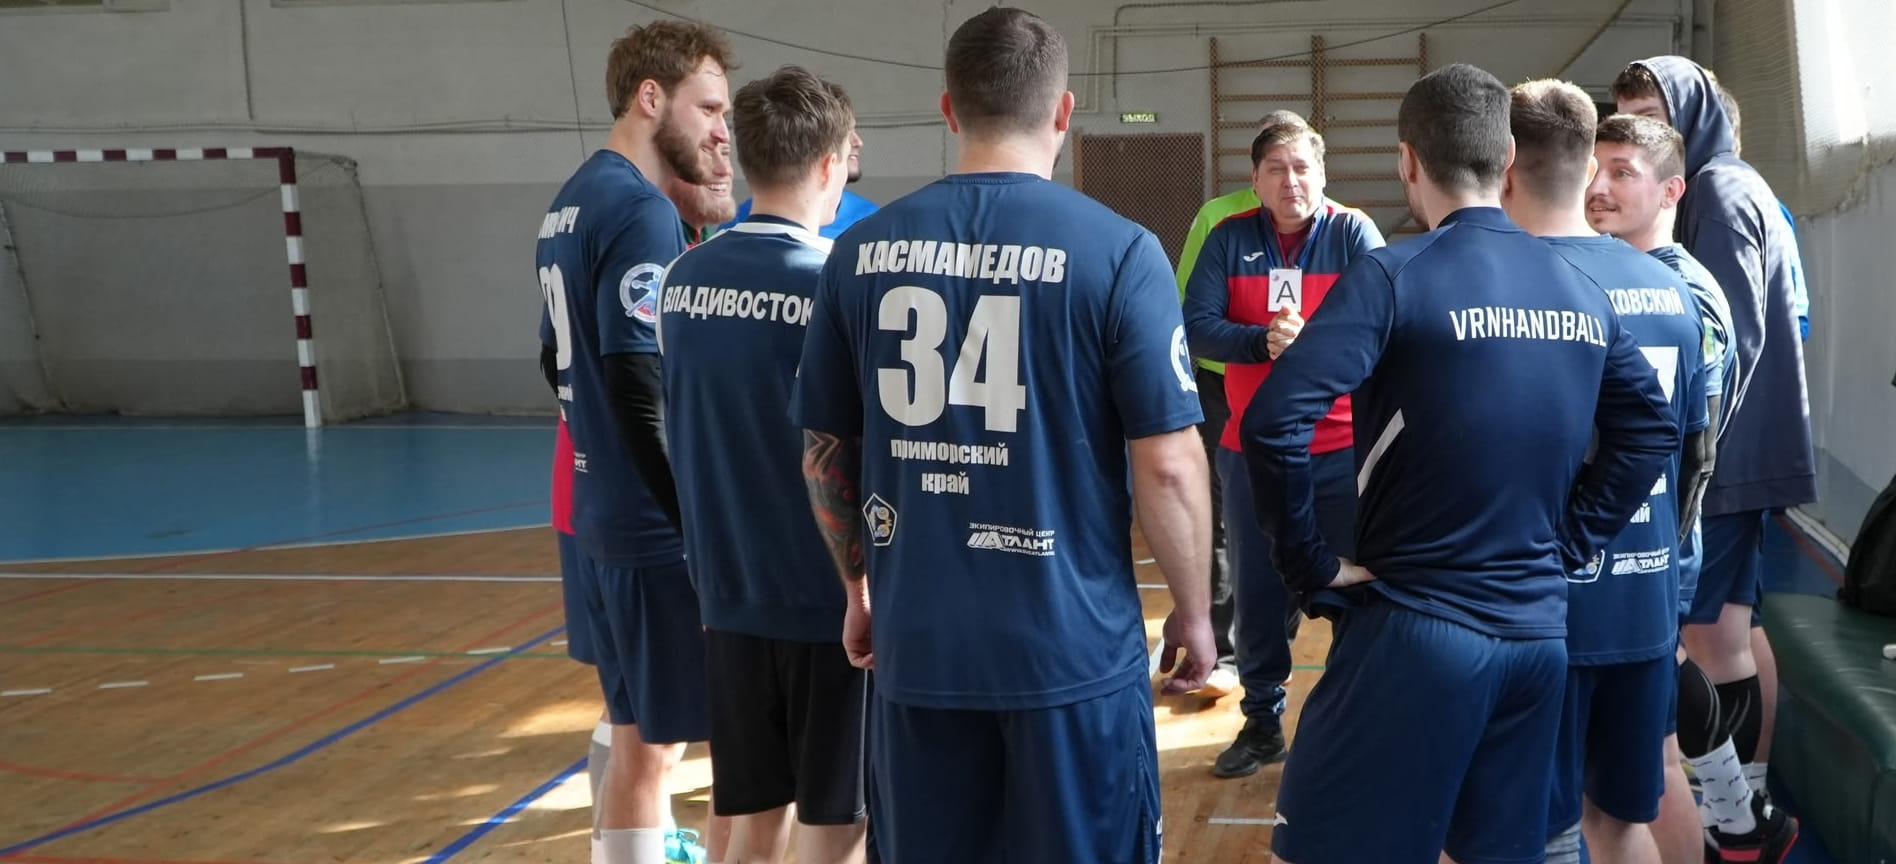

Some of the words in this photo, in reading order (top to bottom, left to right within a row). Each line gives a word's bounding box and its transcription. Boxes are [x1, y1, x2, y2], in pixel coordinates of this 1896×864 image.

[855, 240, 1067, 285] ХАСМАМЕДОВ
[662, 286, 814, 327] ВЛАДИВОСТОК
[1275, 280, 1296, 304] A
[1449, 306, 1607, 348] VRNHANDBALL
[877, 285, 1026, 433] 34
[890, 439, 1009, 467] приморский
[921, 471, 969, 495] край
[967, 531, 1055, 550] АТЛАНТ
